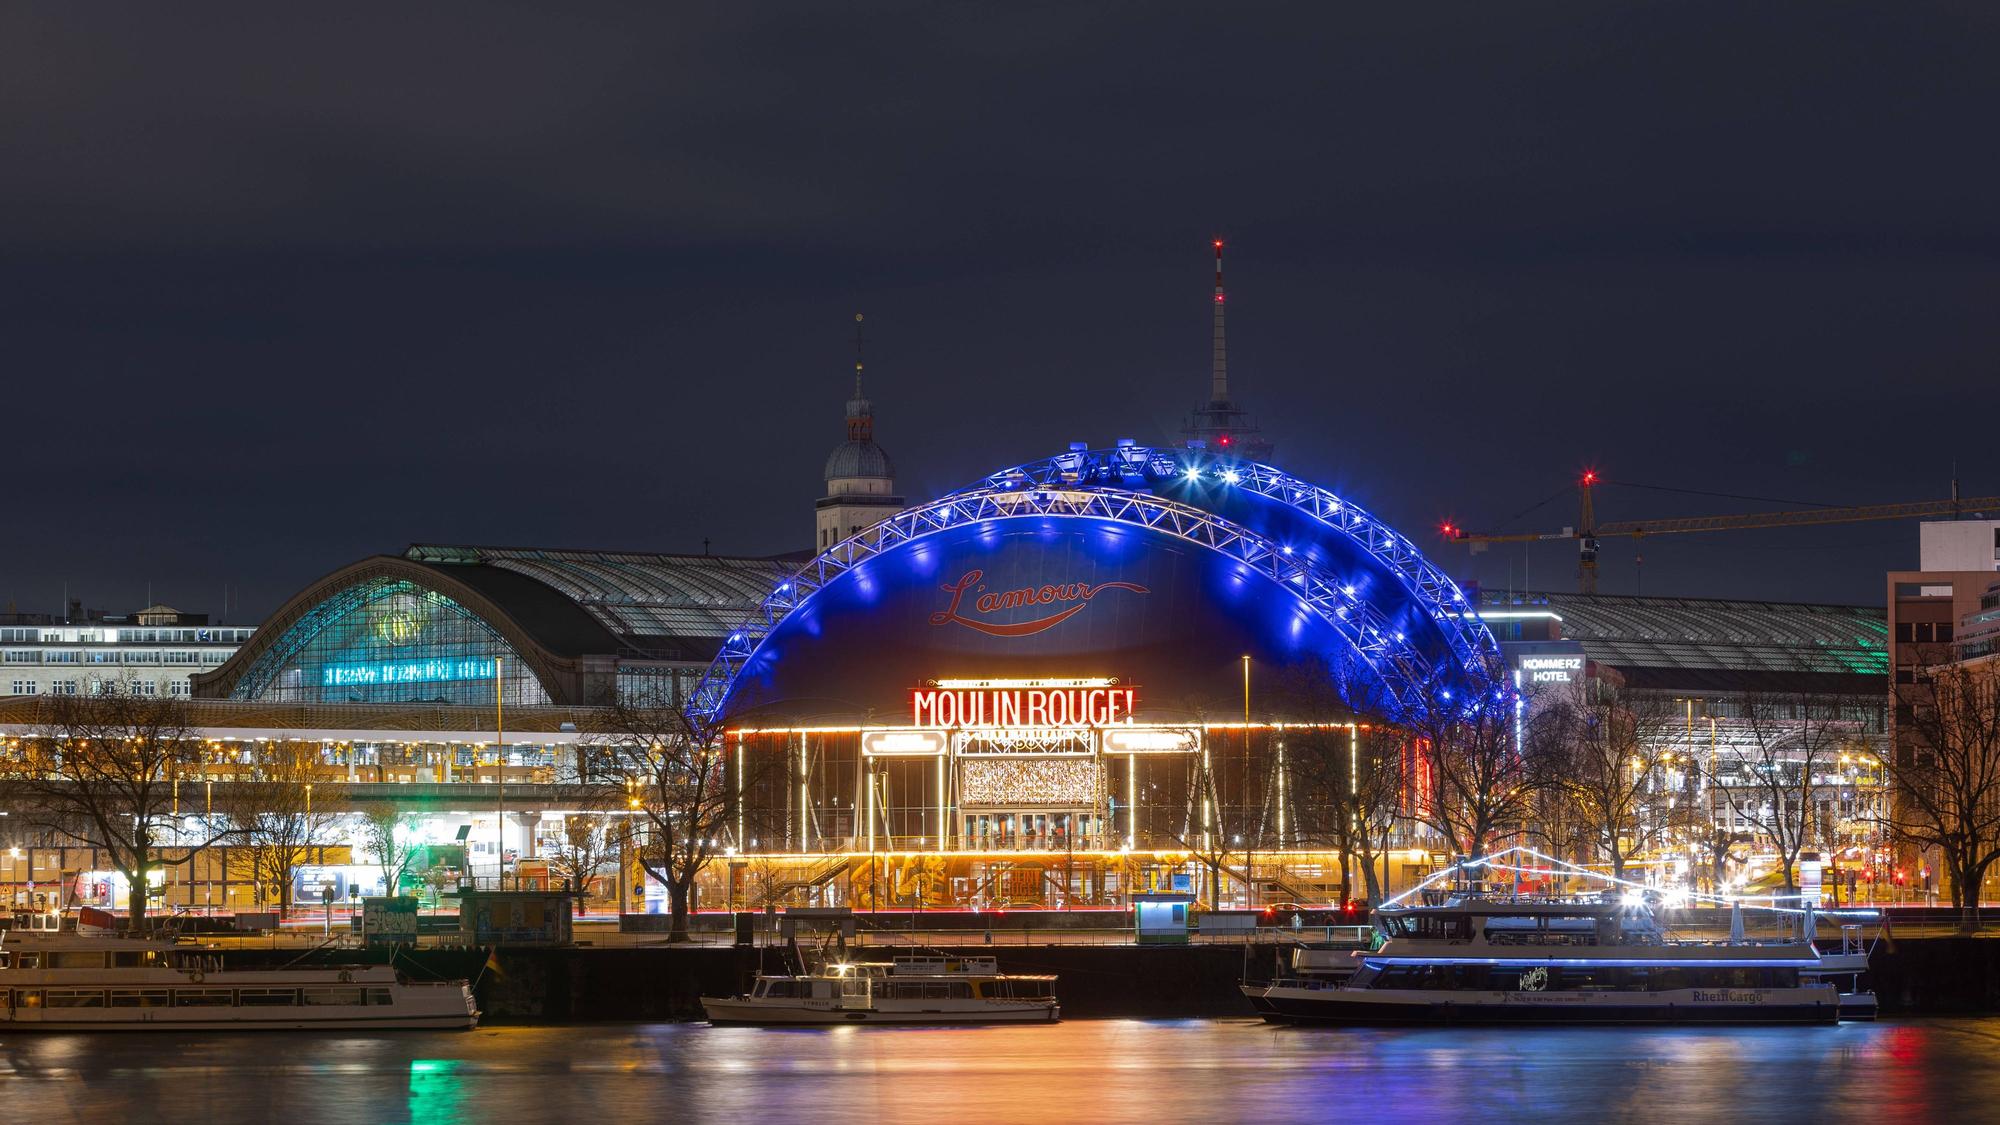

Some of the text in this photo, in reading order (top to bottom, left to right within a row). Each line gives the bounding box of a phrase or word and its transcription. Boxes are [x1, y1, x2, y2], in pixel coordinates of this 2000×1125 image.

[1523, 658, 1581, 670] KOMMERZ
[1533, 671, 1571, 682] HOTEL
[914, 690, 1134, 728] MOULIN ROUGE!
[1693, 990, 1763, 1004] RheinCargo
